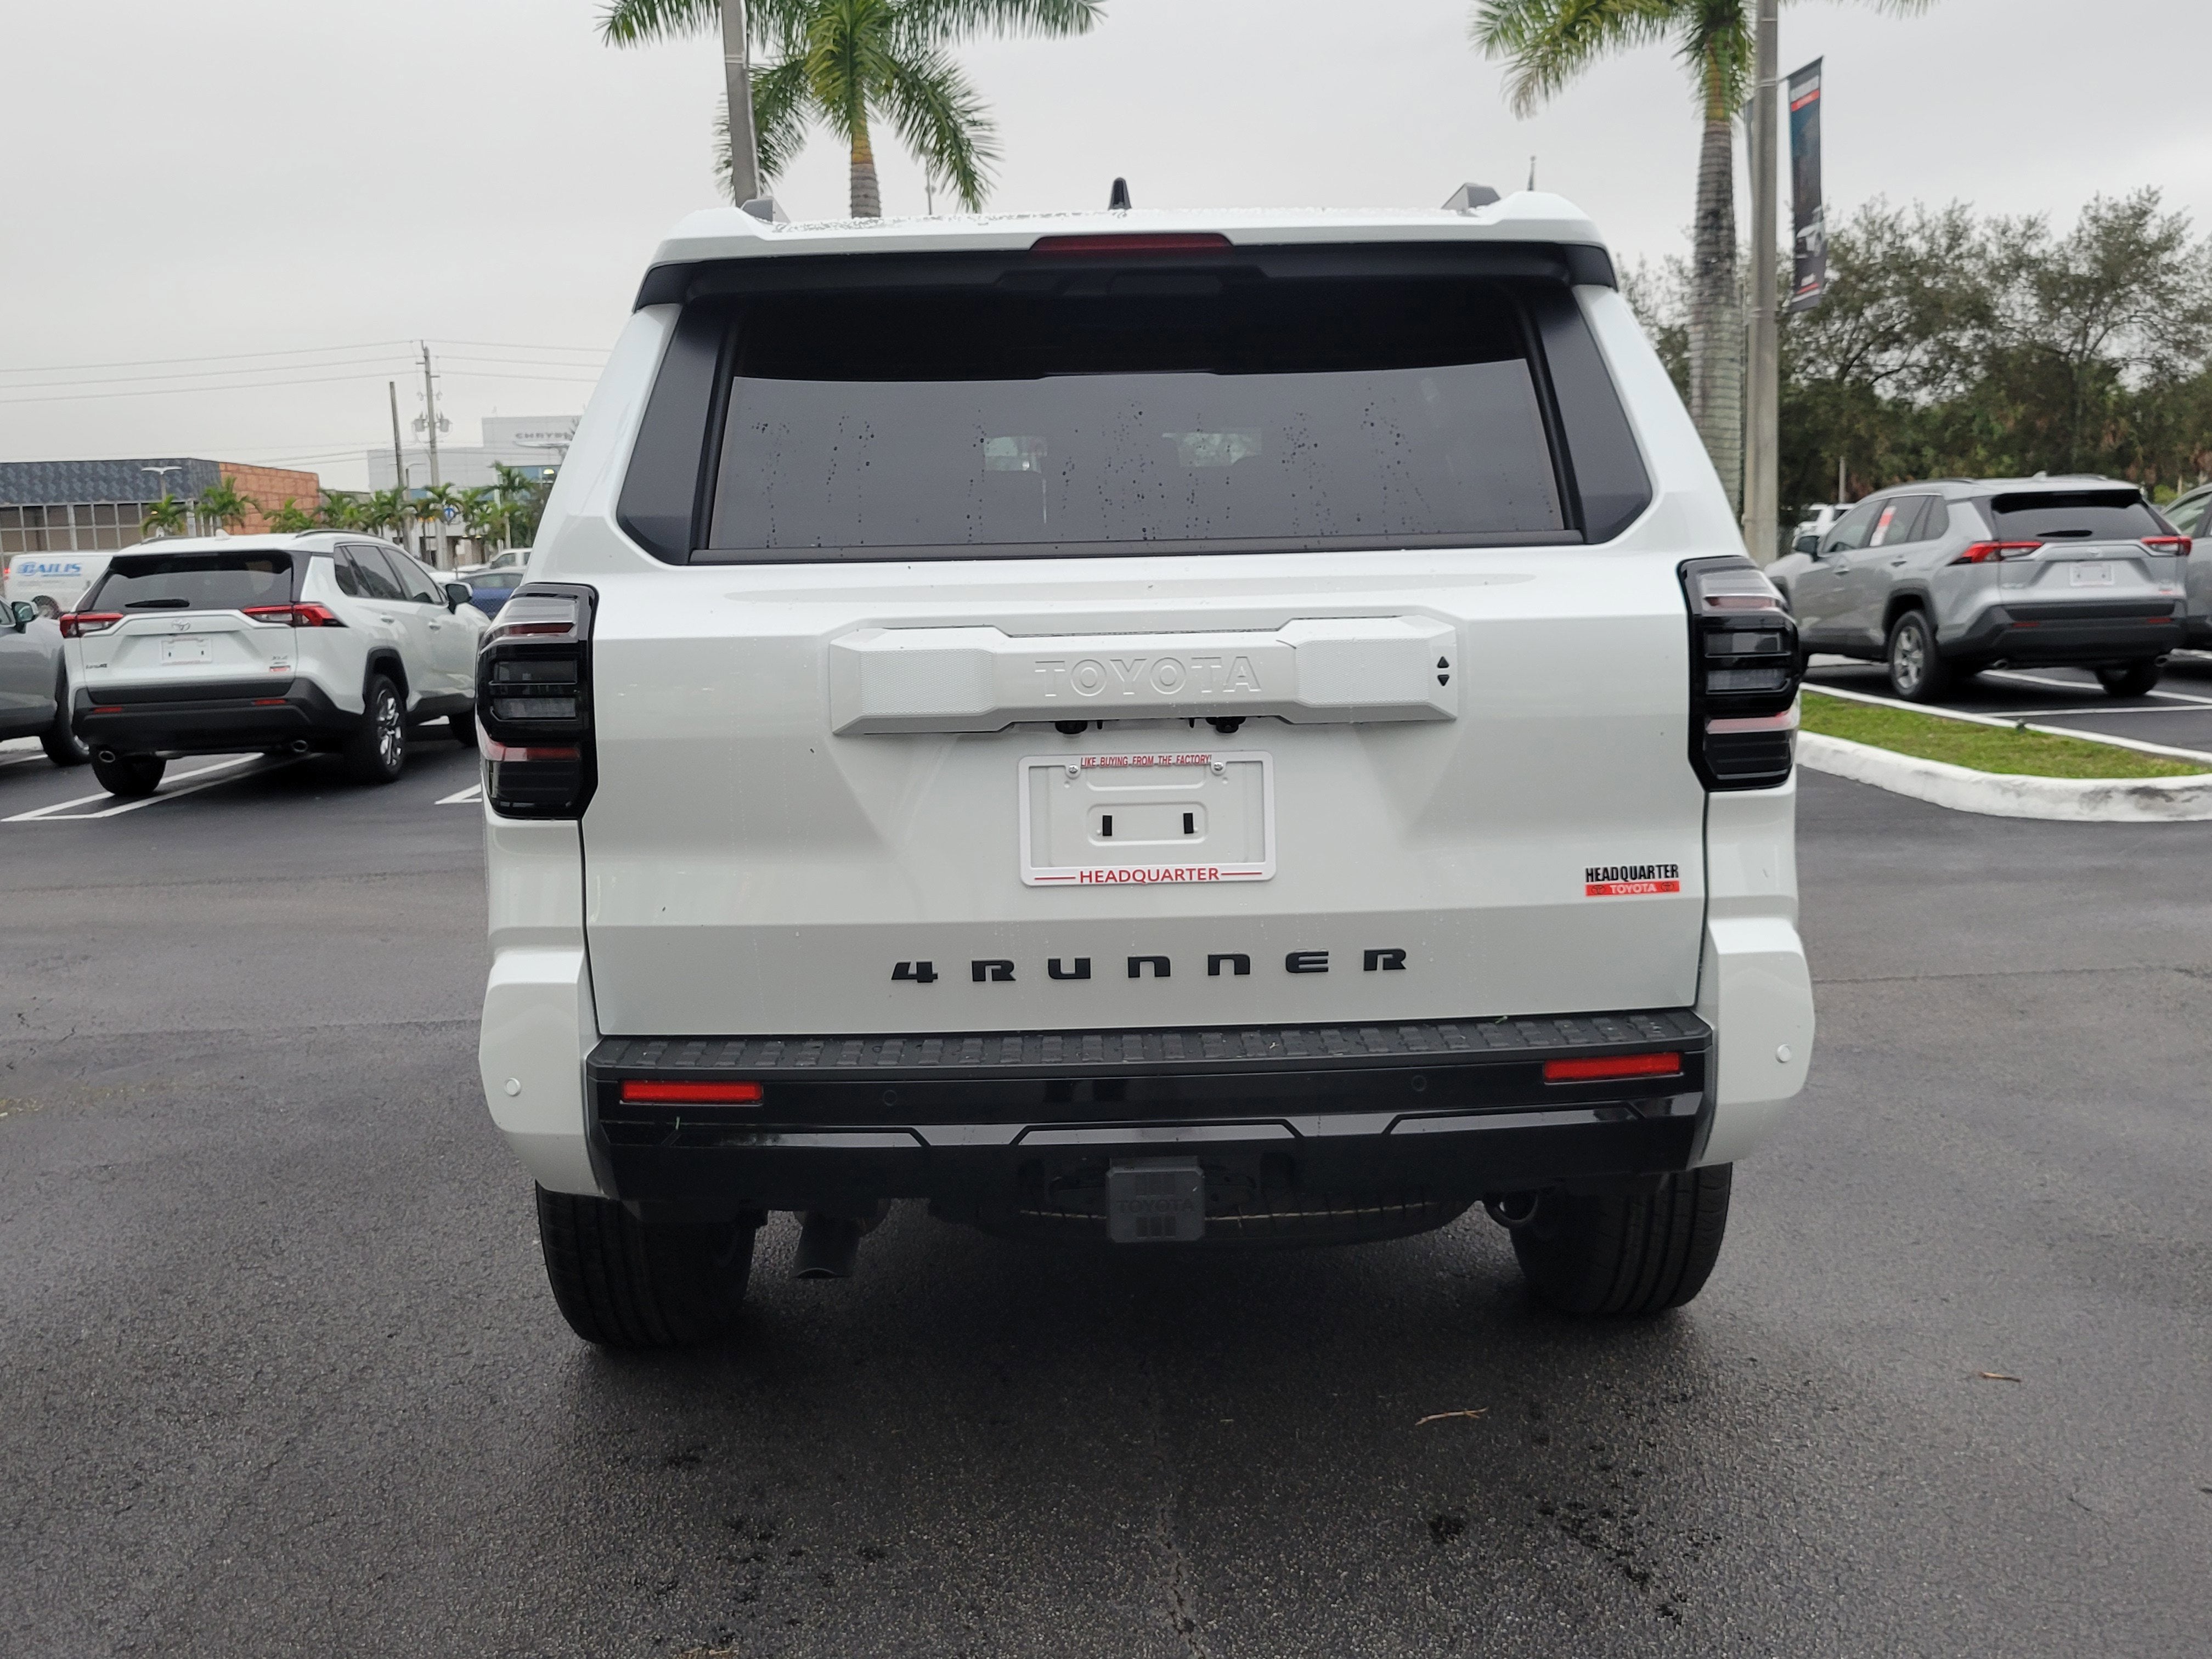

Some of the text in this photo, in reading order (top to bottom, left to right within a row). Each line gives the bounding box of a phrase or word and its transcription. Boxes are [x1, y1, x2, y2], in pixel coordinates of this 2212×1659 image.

[1035, 656, 1261, 697] TOYOTA
[1081, 754, 1212, 767] LIKE BUYING FROM THE FACTORY!
[1080, 867, 1220, 884] HEADQUARTER
[1585, 864, 1679, 883] HEADQUARTER
[1610, 883, 1657, 894] TOYOTA
[891, 947, 1407, 983] 4RUNNER
